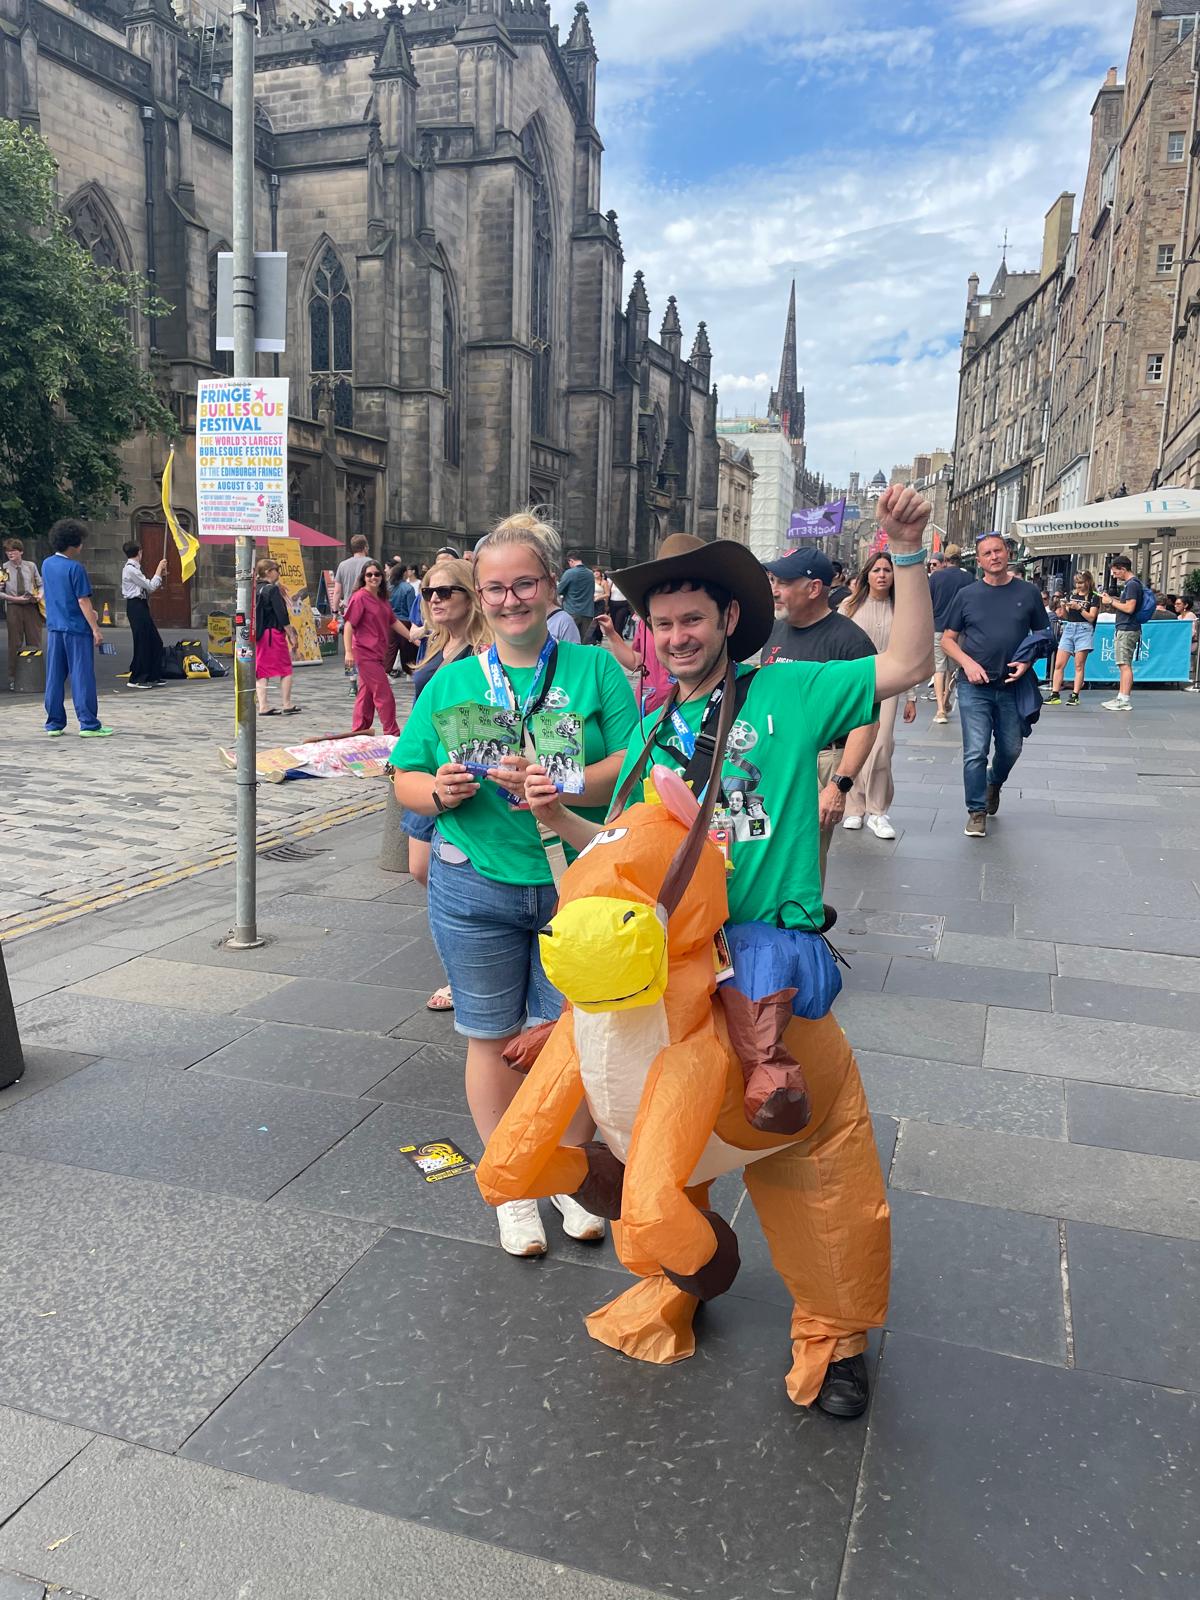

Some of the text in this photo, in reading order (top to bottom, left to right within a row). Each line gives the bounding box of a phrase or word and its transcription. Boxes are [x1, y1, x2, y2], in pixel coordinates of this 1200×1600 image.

[200, 388, 251, 403] FRINGE
[200, 403, 284, 417] BURLESQUE
[200, 417, 262, 431] FESTIVAL
[200, 436, 283, 446] THE WORLD'S LARGEST
[200, 446, 283, 456] BURLESQUE FESTIVAL
[200, 457, 283, 466] OF ITS KIND
[200, 467, 207, 477] AT
[208, 467, 220, 477] THE
[221, 467, 257, 477] EDINBURGH
[218, 481, 264, 490] AUGUST 6-30
[1024, 519, 1120, 534] Luckenbooths
